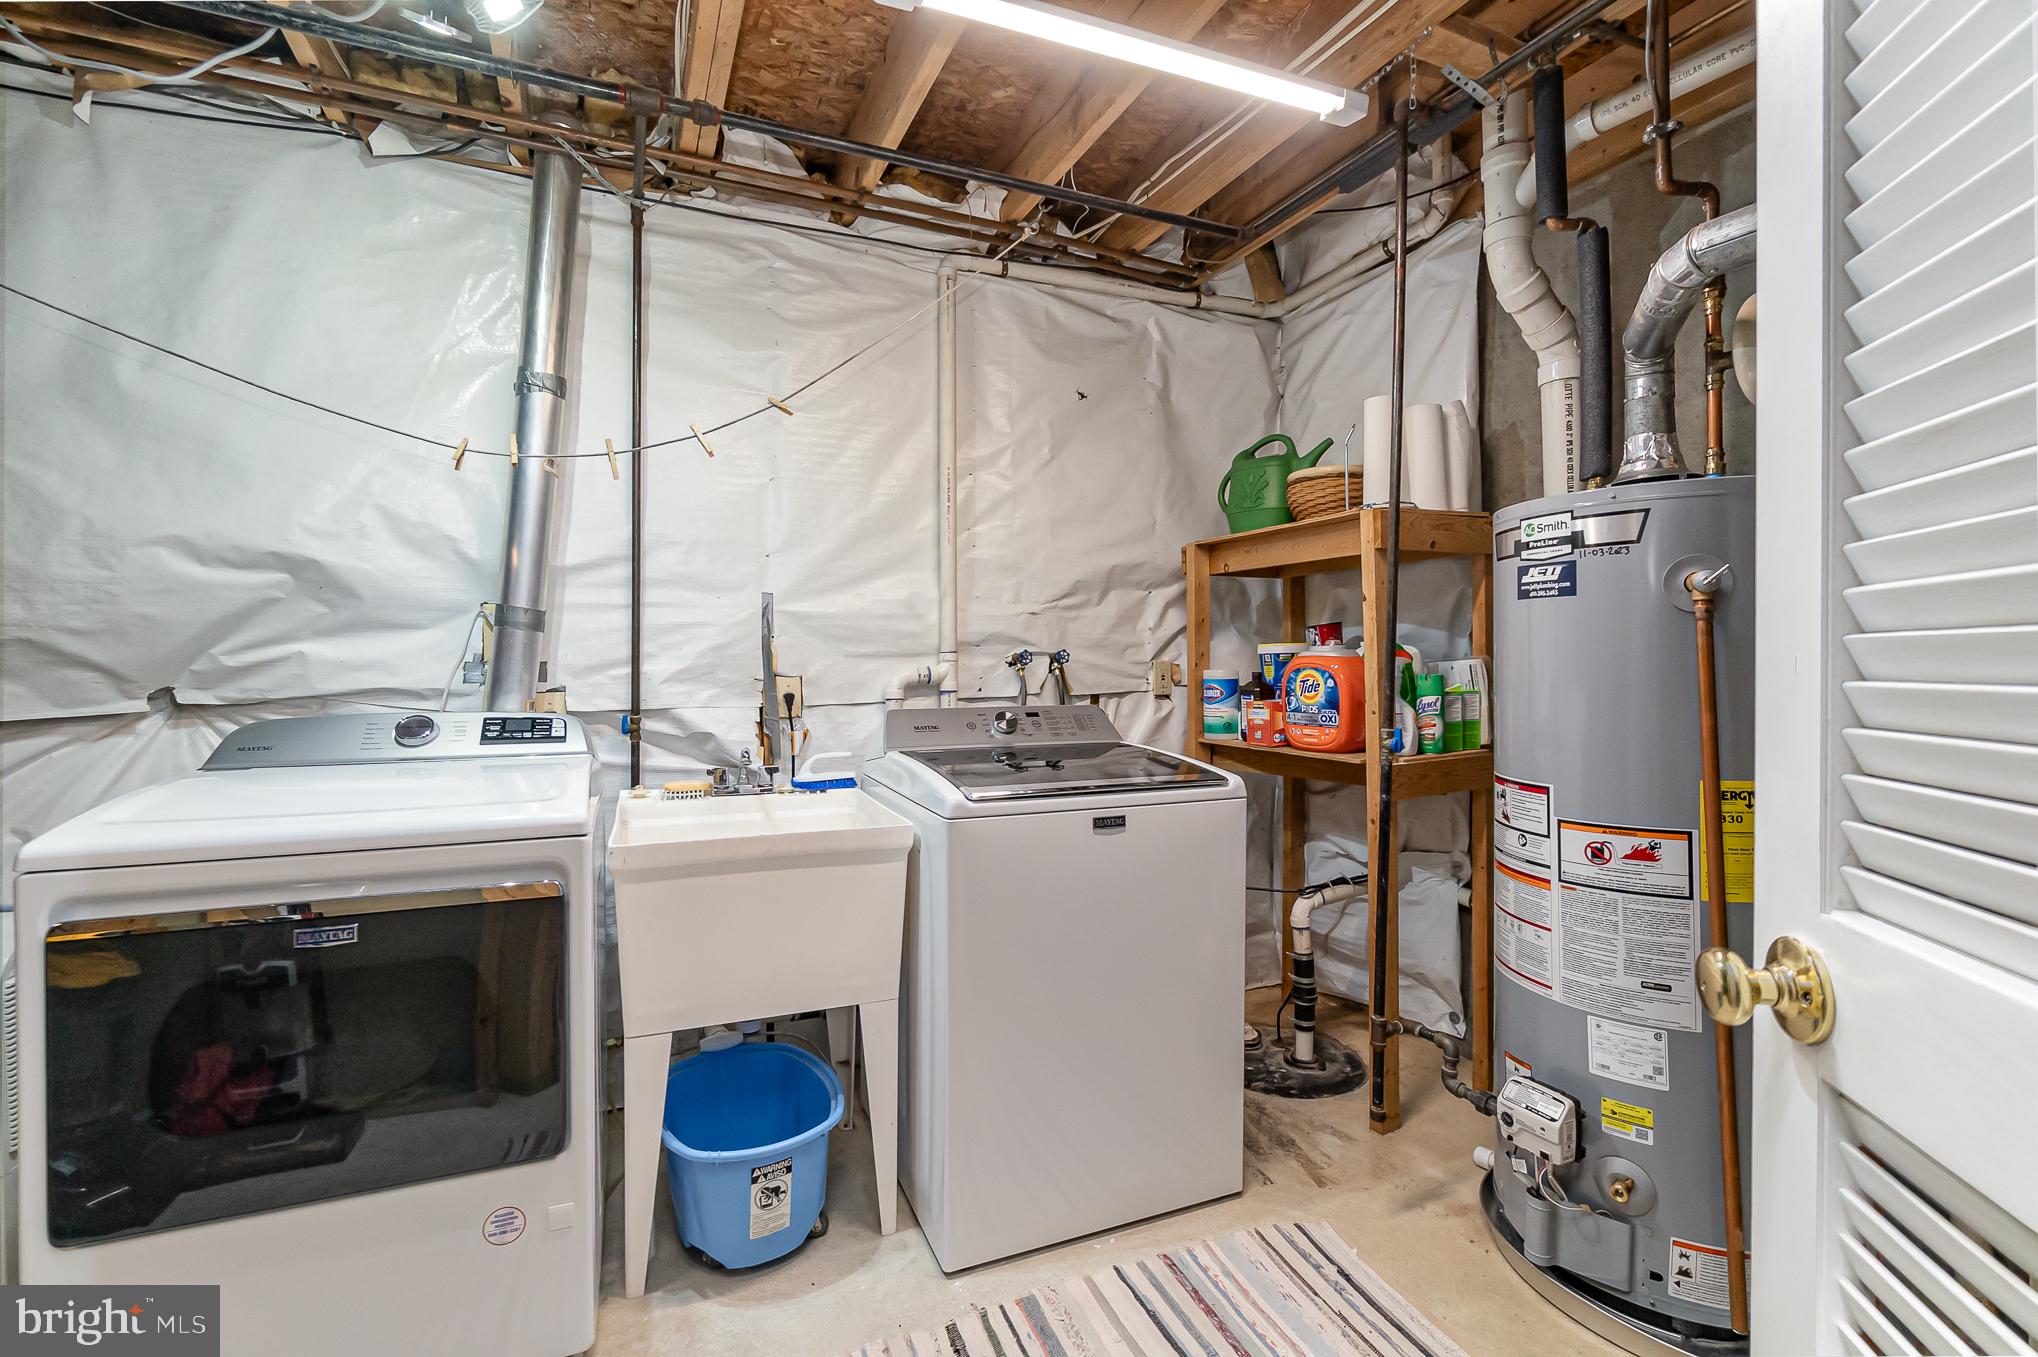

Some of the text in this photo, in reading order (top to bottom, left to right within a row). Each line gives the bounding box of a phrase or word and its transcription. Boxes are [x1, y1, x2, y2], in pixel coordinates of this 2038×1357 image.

[1669, 63, 1703, 86] ELLULAR
[1706, 52, 1728, 68] CORE
[1631, 94, 1641, 103] 40
[1565, 403, 1574, 418] PIPE
[1299, 677, 1321, 697] Tide
[1417, 696, 1440, 713] Lysol
[1320, 714, 1338, 724] OXI
[1095, 818, 1125, 827] MAYTAG
[1608, 830, 1638, 838] WARNING
[298, 929, 354, 944] MAYTAG
[760, 1158, 792, 1175] WARNING
[766, 1168, 787, 1181] AVISO
